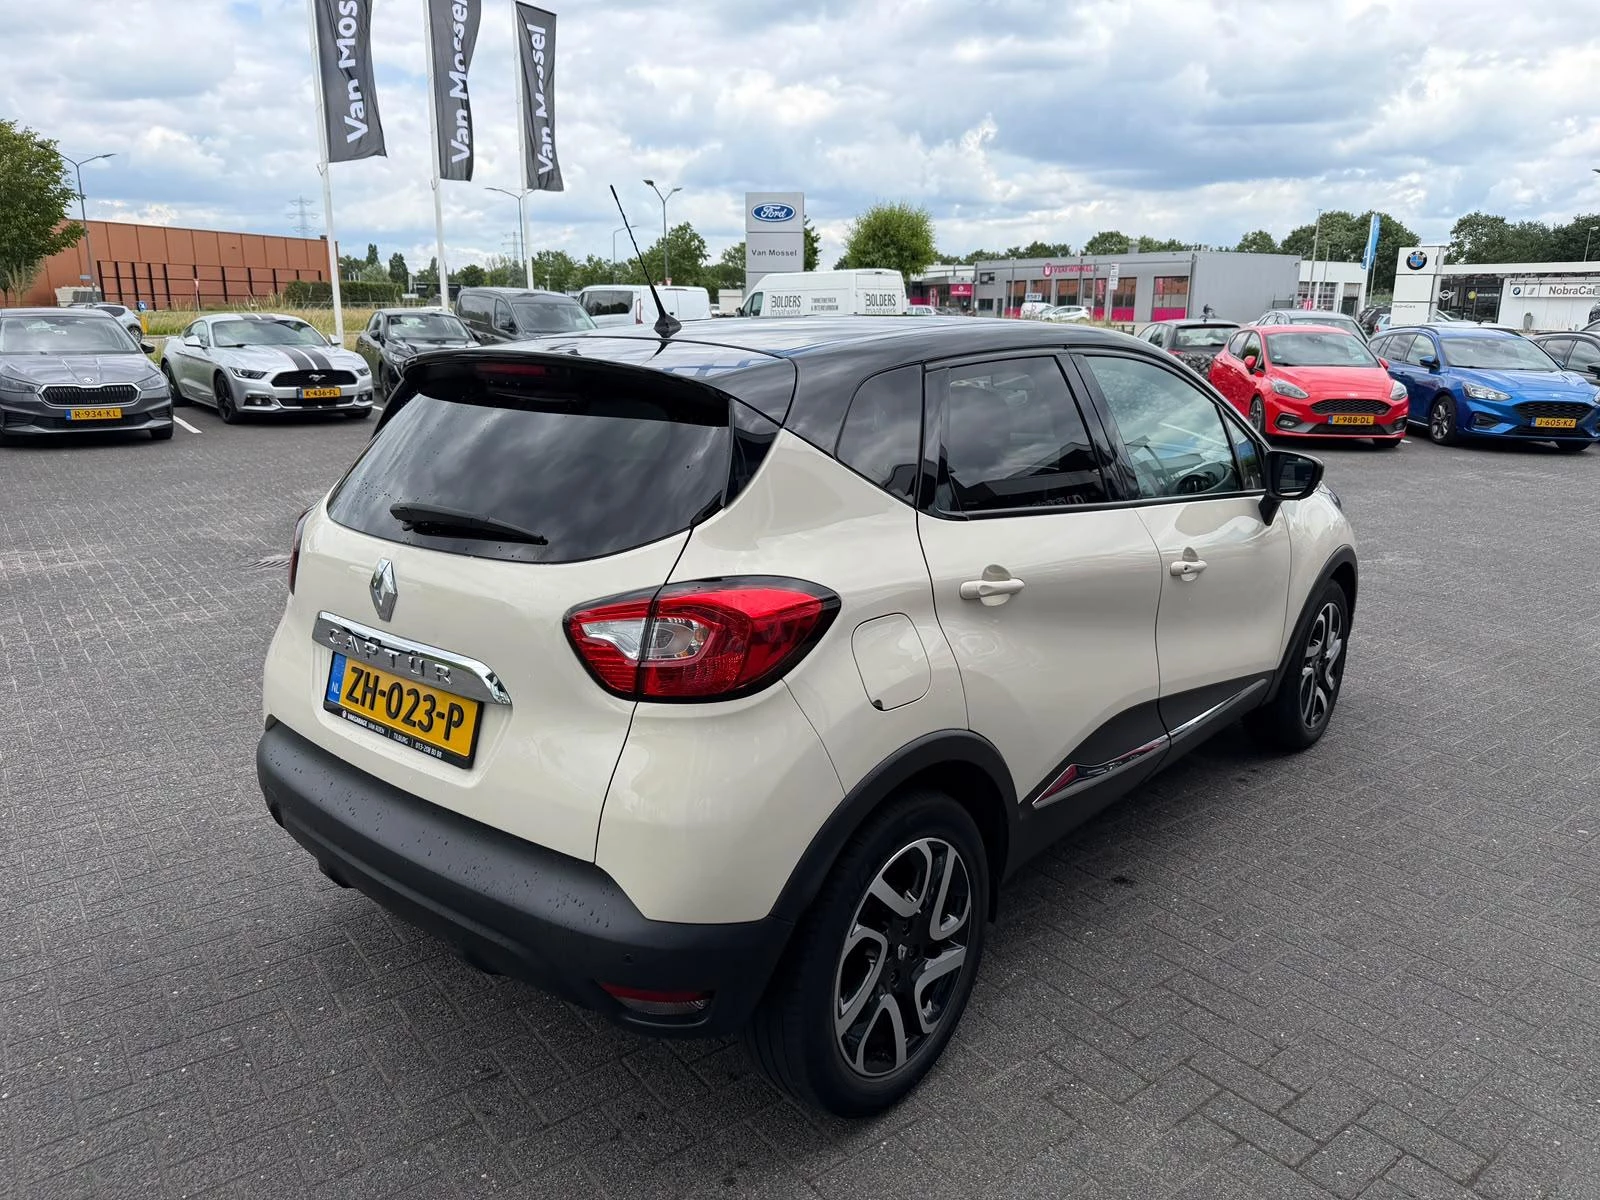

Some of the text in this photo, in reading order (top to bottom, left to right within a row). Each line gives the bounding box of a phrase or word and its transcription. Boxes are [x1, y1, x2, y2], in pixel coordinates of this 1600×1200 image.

[344, 78, 369, 144] Van
[451, 108, 471, 163] Van
[538, 126, 553, 175] Van
[751, 249, 798, 257] Van Mossel
[304, 388, 339, 399] K-436-FL
[74, 409, 119, 420] R-934-KL
[1334, 415, 1371, 425] J-988-DL
[1537, 418, 1575, 428] J-605-KZ
[328, 628, 452, 685] CAPTUR
[331, 681, 340, 695] NL
[346, 666, 464, 741] ZH-023-P
